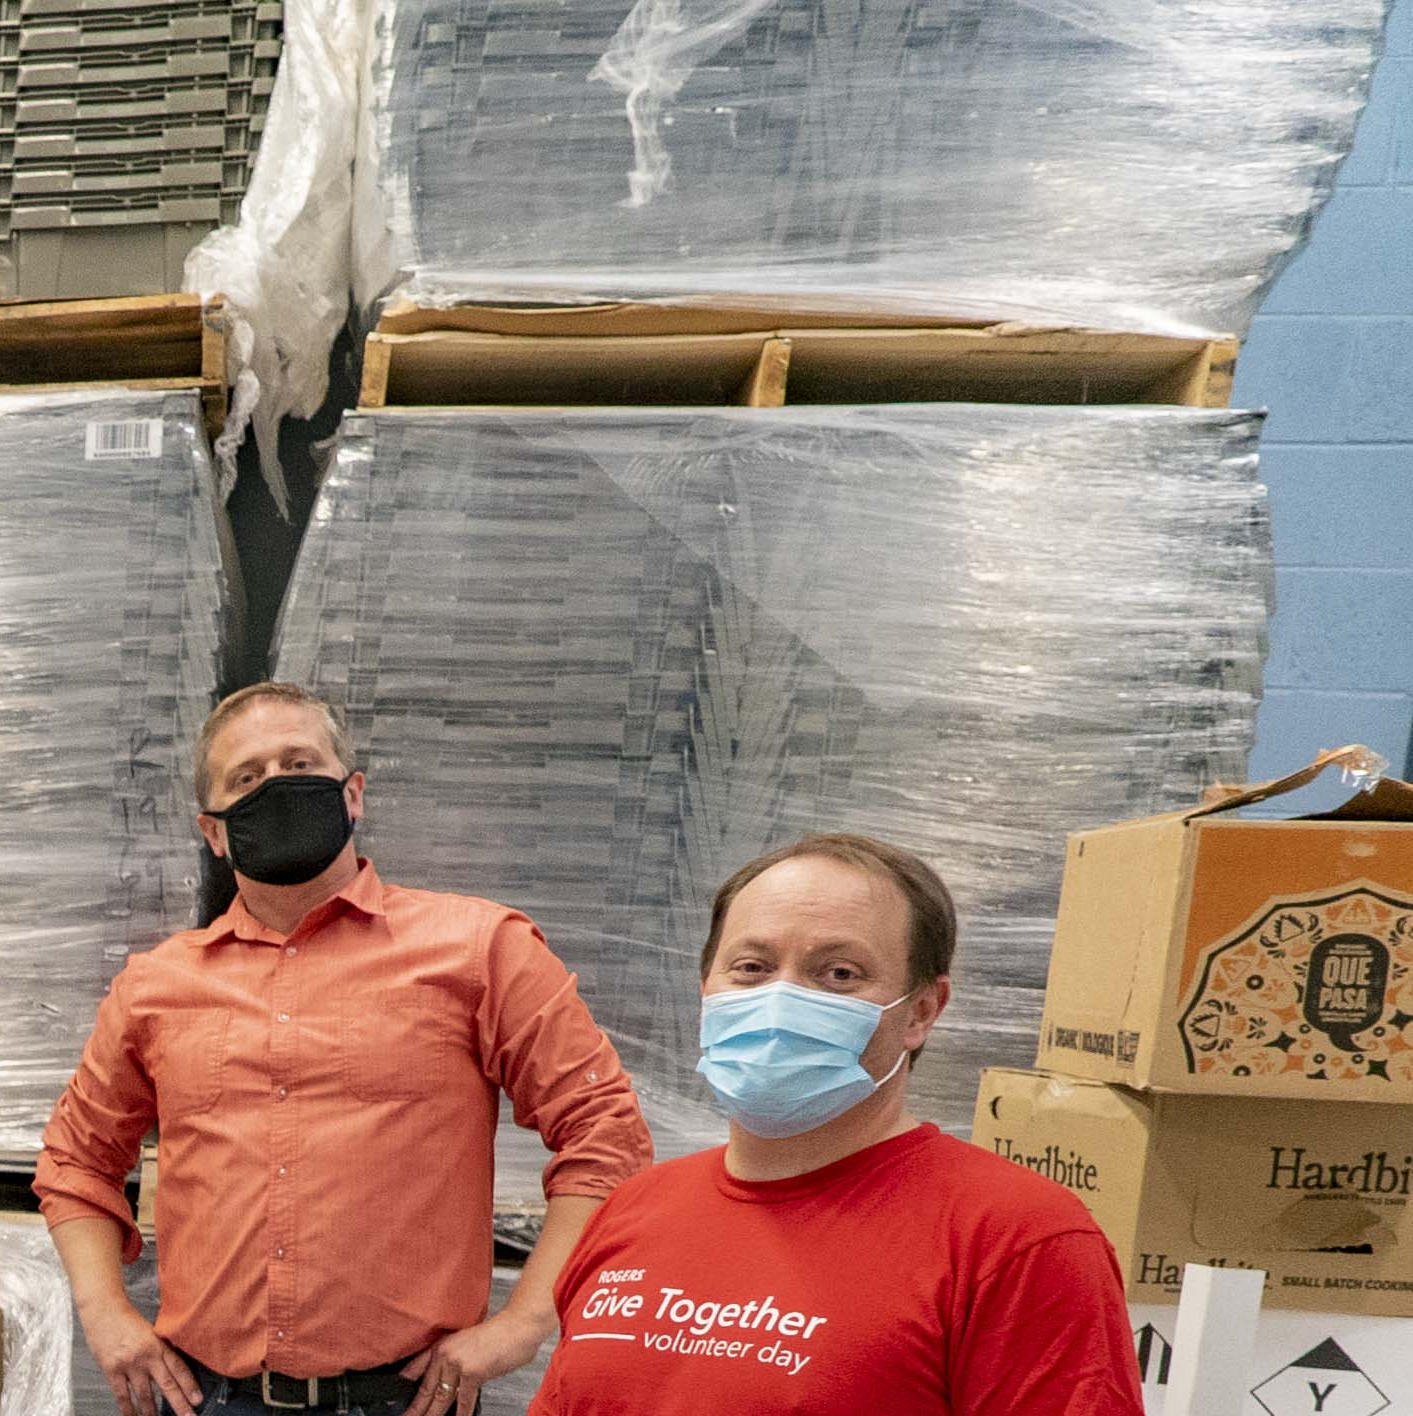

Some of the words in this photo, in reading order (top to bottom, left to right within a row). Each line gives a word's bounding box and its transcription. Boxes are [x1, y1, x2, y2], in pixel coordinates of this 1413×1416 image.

[1322, 955, 1374, 987] QUE
[1318, 987, 1367, 1010] PASA
[1266, 1146, 1413, 1195] Hardbi
[598, 1269, 646, 1284] ROGERS
[1281, 1276, 1321, 1289] SMALL
[1324, 1277, 1363, 1290] BATCH
[582, 1287, 644, 1320] Give
[655, 1287, 827, 1339] Together
[643, 1329, 754, 1359] volunteer
[757, 1341, 811, 1376] day
[1307, 1381, 1337, 1412] Y
